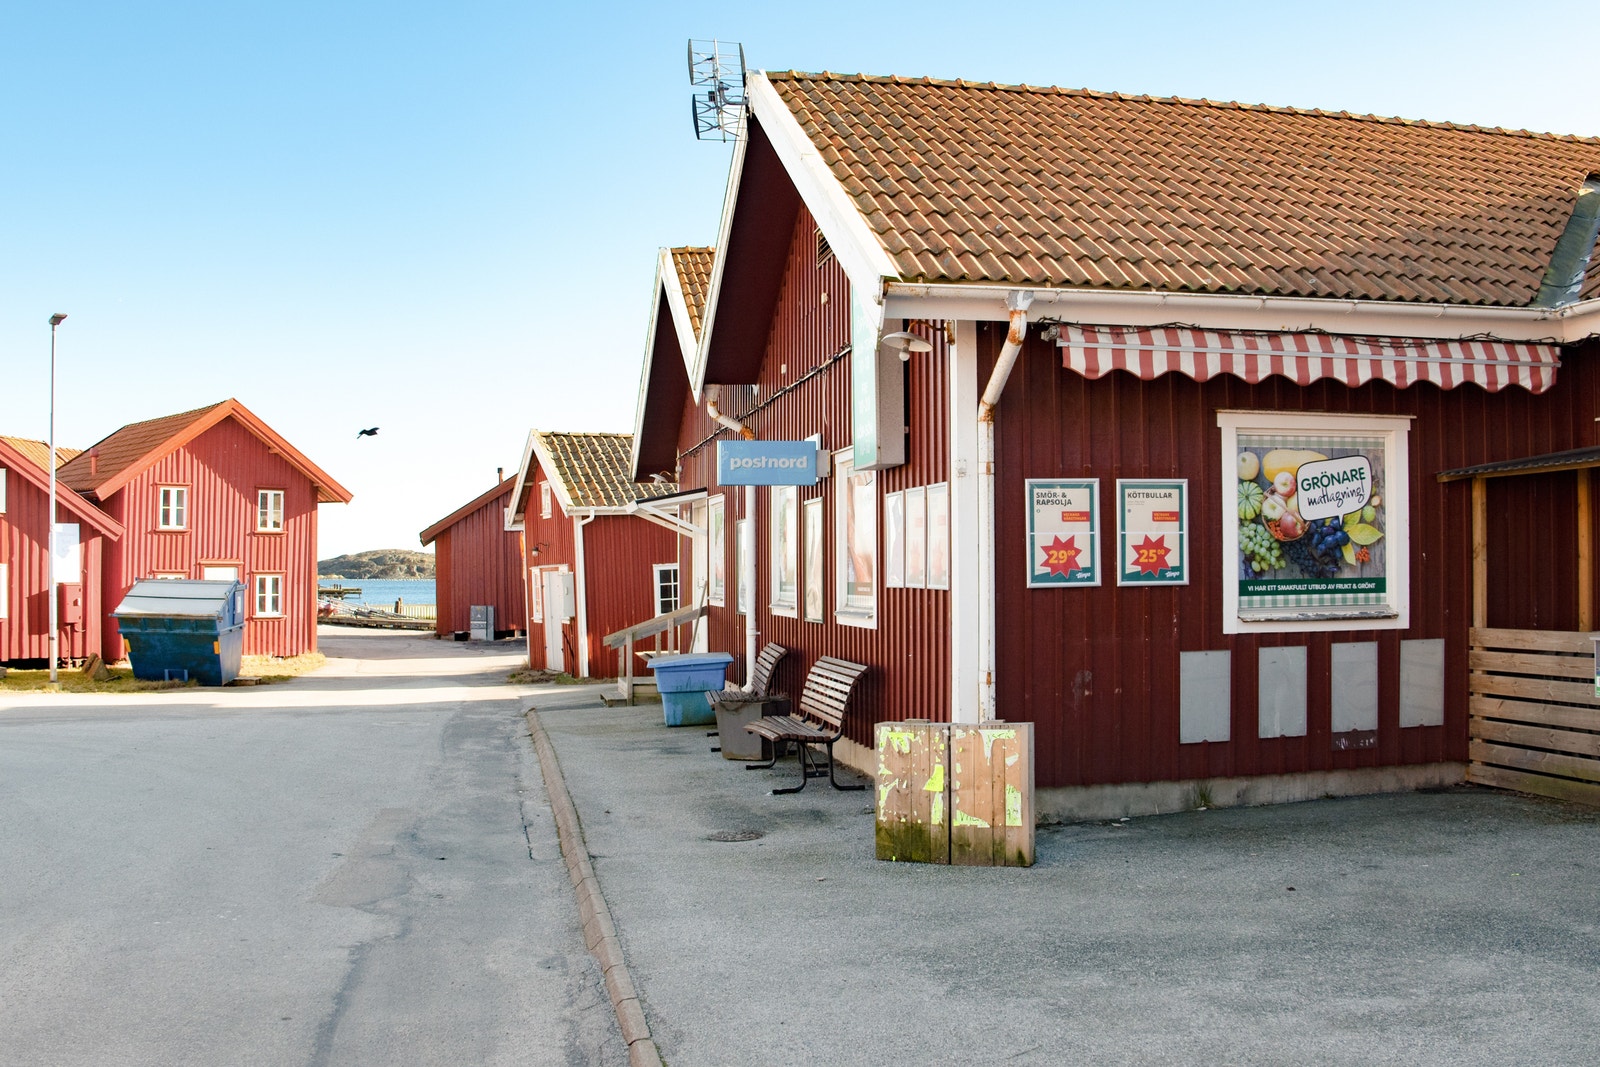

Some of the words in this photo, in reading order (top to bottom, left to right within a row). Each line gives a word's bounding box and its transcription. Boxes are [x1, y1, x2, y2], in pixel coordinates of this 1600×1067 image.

[730, 456, 807, 470] postnord
[1301, 467, 1366, 491] GRÖNARE
[1036, 491, 1060, 499] SMÖR-
[1127, 491, 1173, 499] KÖTTBULLAR
[1307, 480, 1365, 508] matlagning!
[1036, 499, 1072, 507] RAPSOLJA
